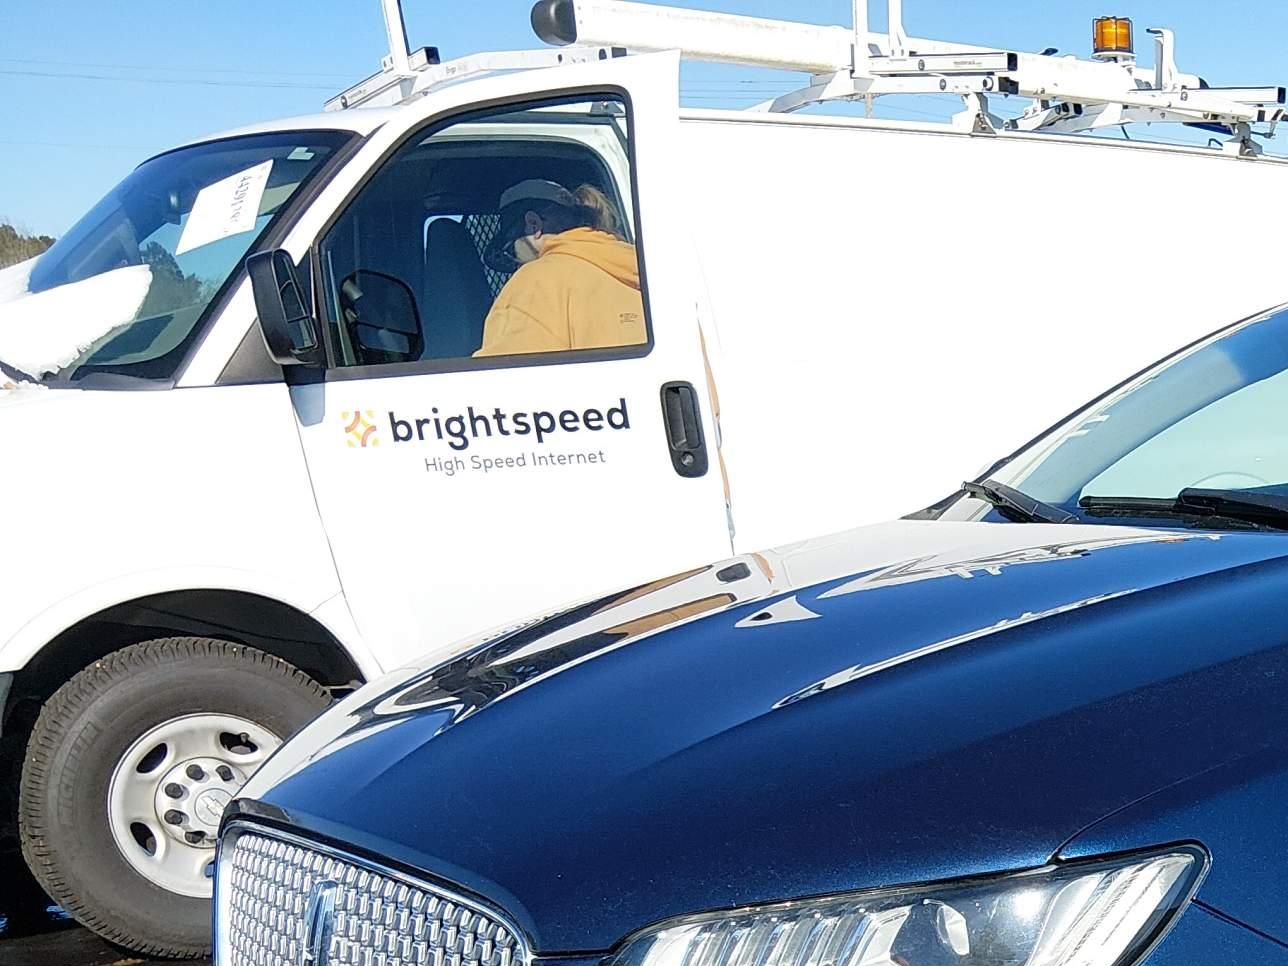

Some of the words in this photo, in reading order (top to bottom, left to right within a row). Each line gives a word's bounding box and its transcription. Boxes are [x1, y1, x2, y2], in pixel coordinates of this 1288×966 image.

[388, 398, 631, 452] brightspeed
[424, 456, 466, 477] High
[471, 452, 527, 474] Speed
[531, 450, 607, 467] Internet
